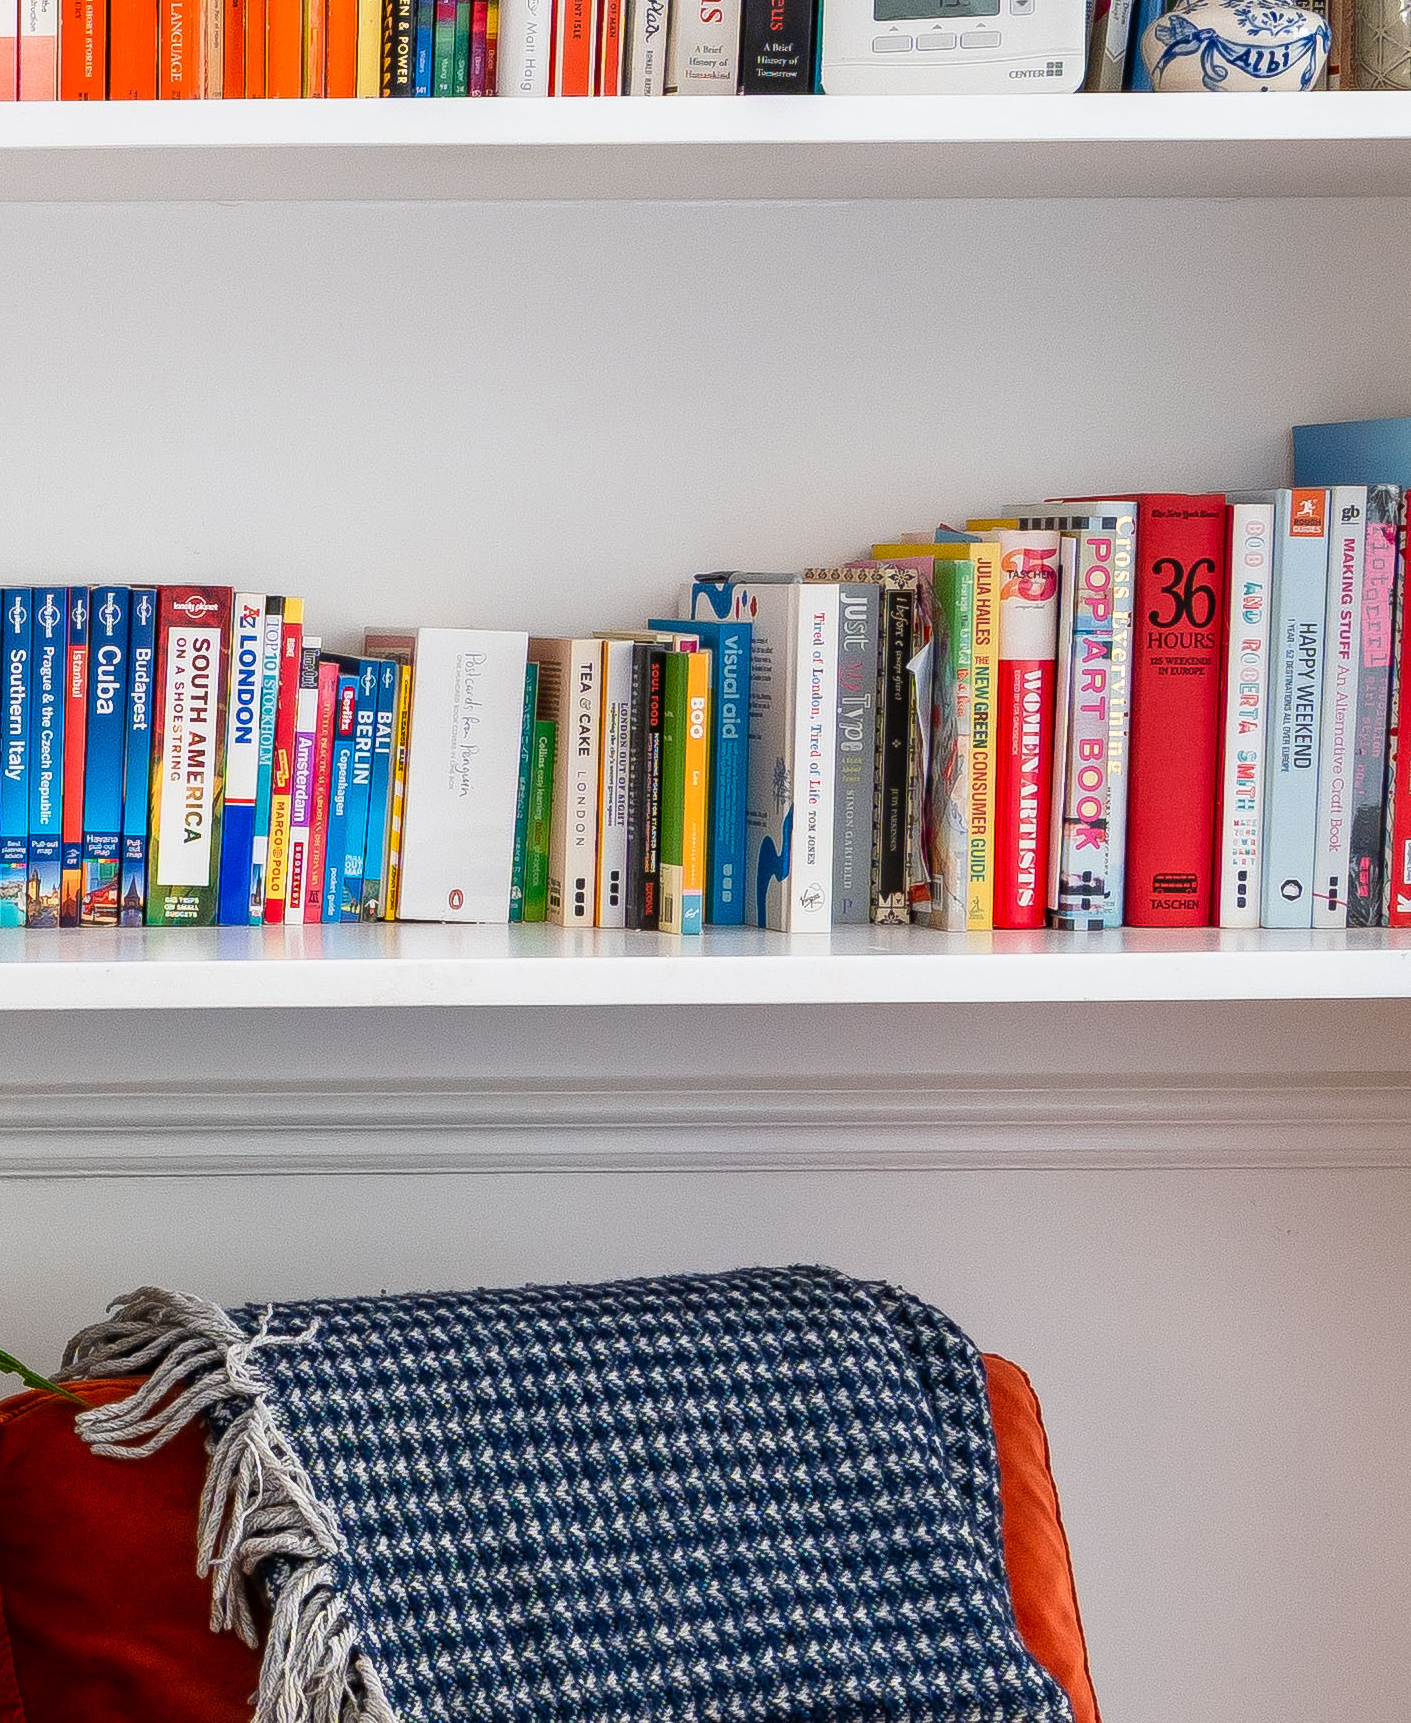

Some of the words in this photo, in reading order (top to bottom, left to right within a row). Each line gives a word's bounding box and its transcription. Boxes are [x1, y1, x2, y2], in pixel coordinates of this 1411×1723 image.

[170, 3, 182, 82] LANGUAGE
[397, 34, 410, 84] POWER
[398, 22, 410, 30] &
[1235, 44, 1291, 74] Albi
[1009, 69, 1045, 79] CENTER
[1148, 558, 1215, 628] 36
[1148, 633, 1215, 649] HOURS
[1299, 623, 1317, 678] HAPPY
[96, 645, 121, 714] Cuba
[132, 648, 150, 730] Budapest
[189, 638, 210, 723] SOUTH
[235, 635, 256, 744] LONDON
[353, 710, 374, 784] BERLIN
[1022, 669, 1042, 773] WOMEN
[1294, 685, 1315, 769] WEEKEND
[184, 731, 204, 843] AMERICA
[293, 736, 313, 822] Amsterdam
[1018, 782, 1036, 907] ARTISTS
[1151, 899, 1199, 909] TASCHEN
